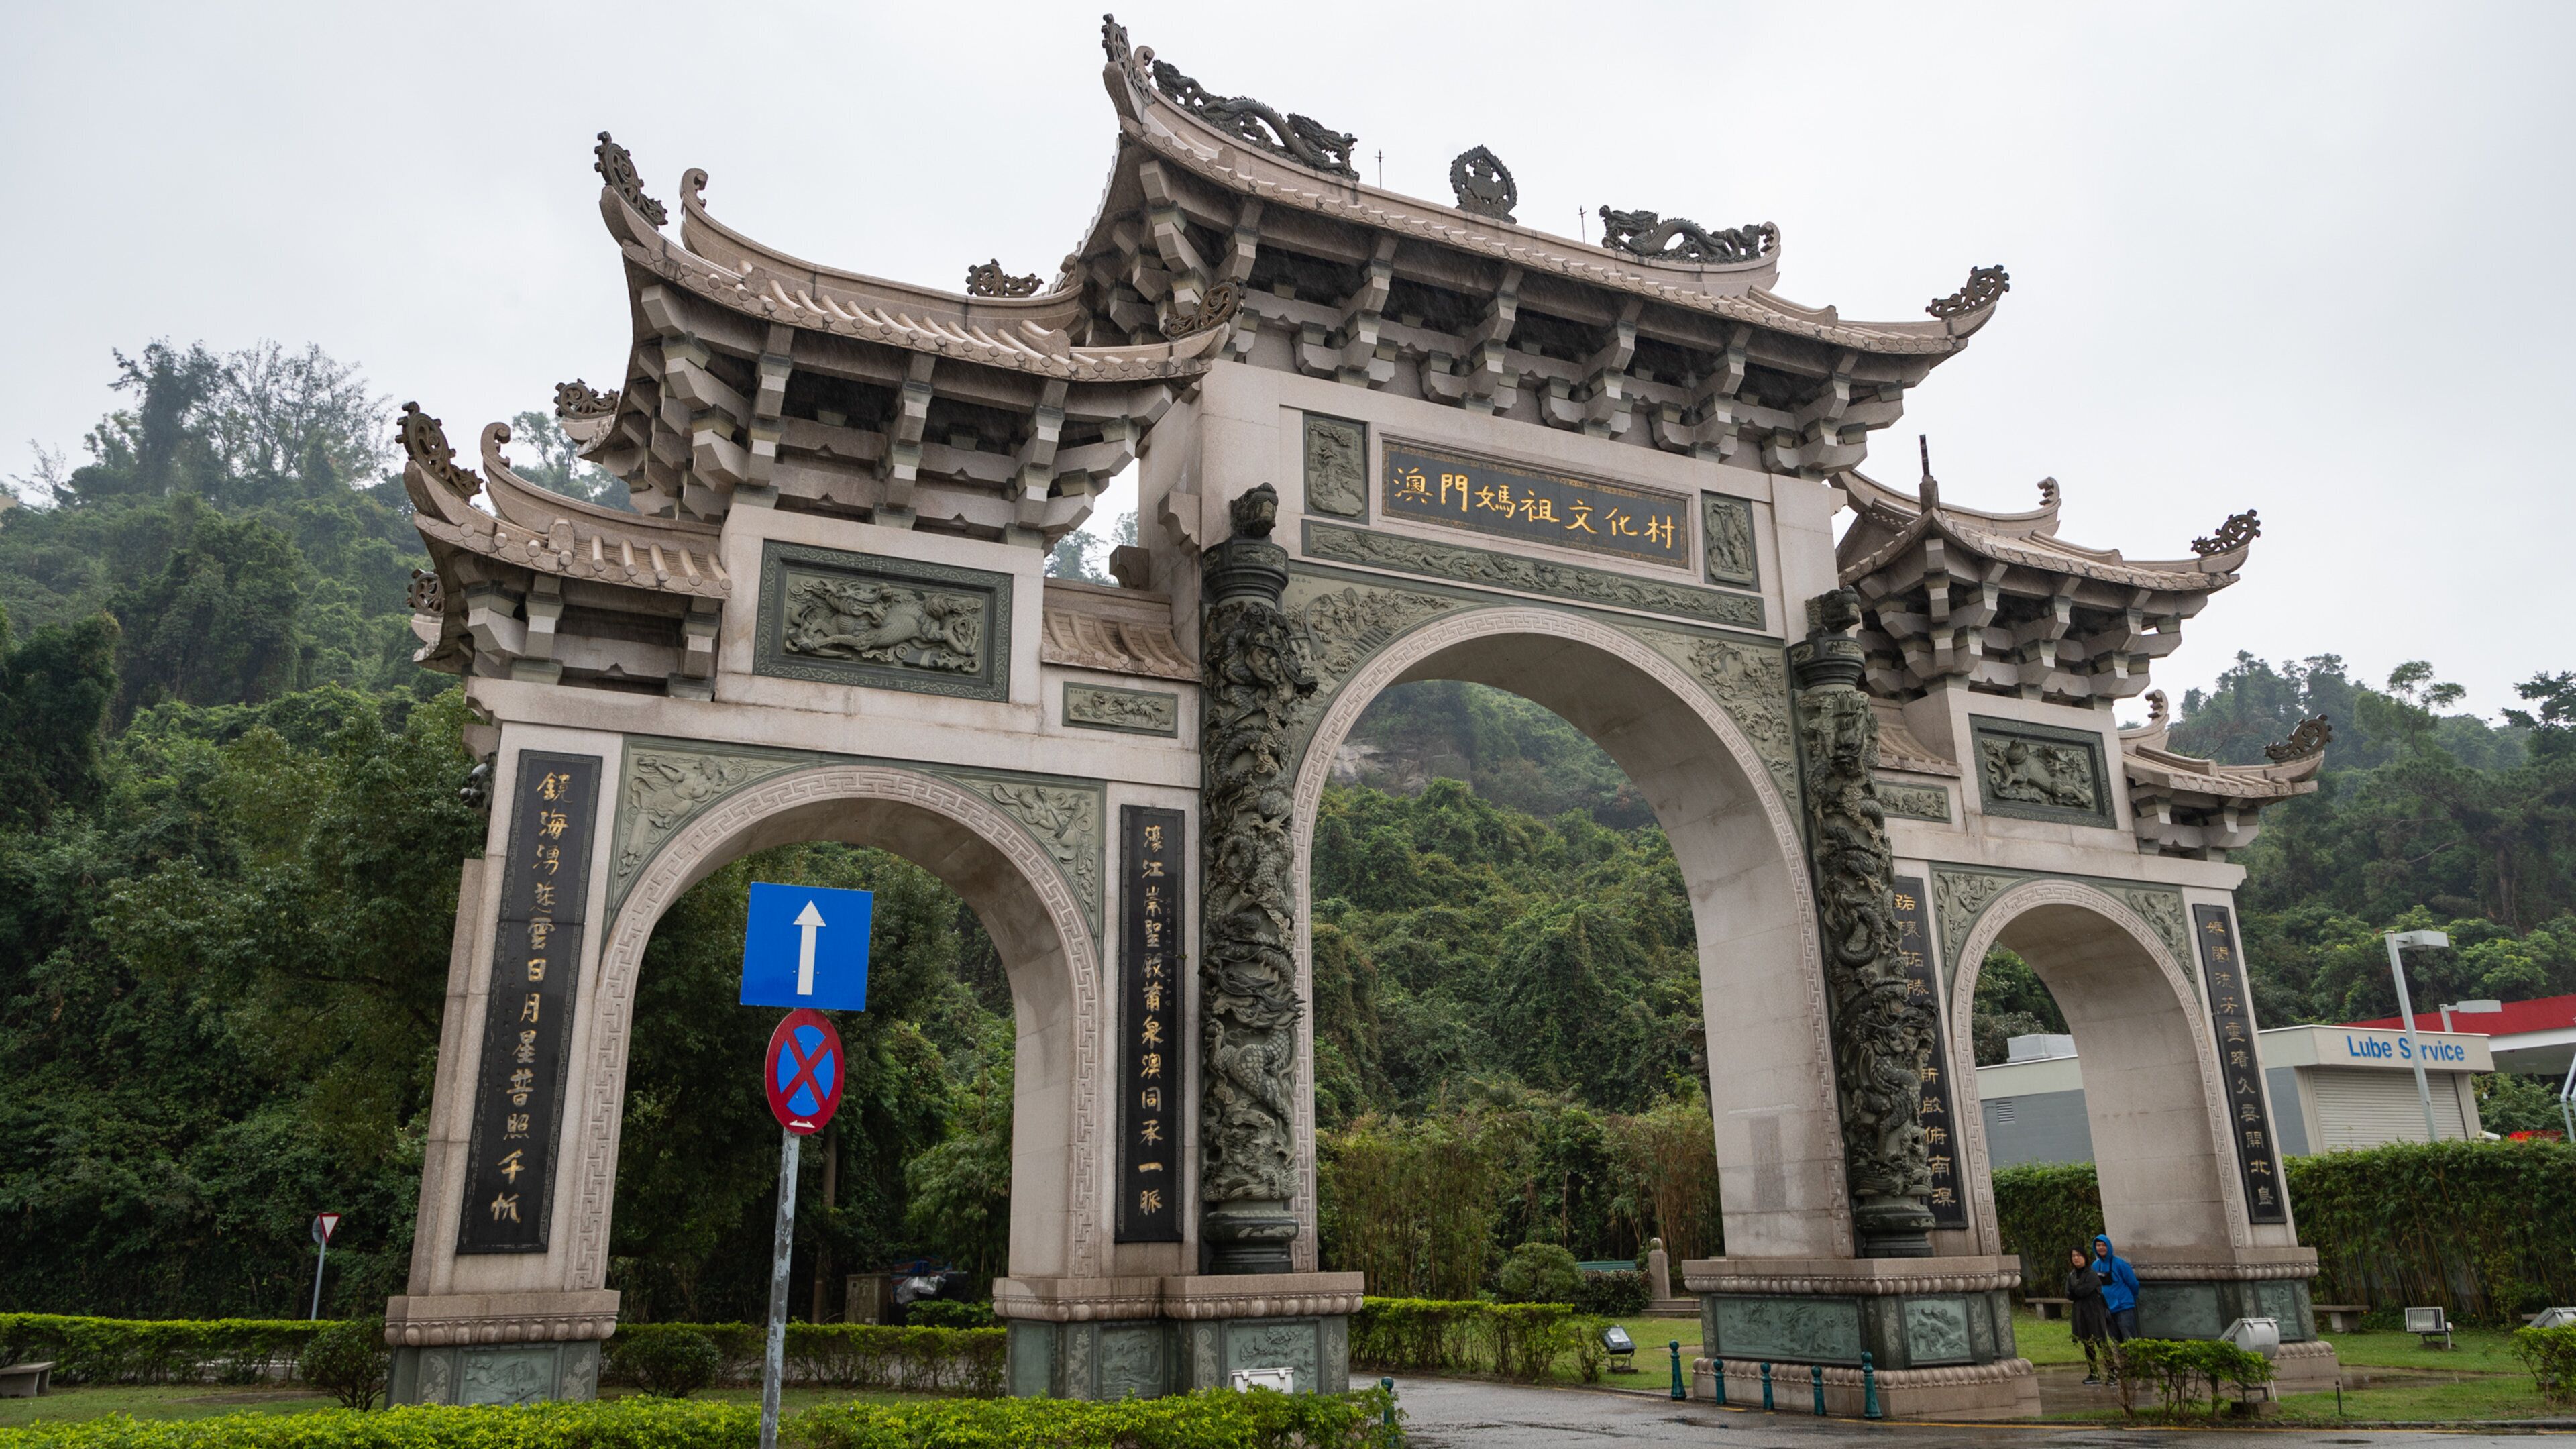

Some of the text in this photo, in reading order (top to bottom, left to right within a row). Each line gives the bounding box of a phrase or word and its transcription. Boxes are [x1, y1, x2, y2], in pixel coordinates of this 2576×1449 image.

[1393, 466, 1676, 549] 澳門媽祖文化村
[2347, 1035, 2465, 1061] Lube Srvice
